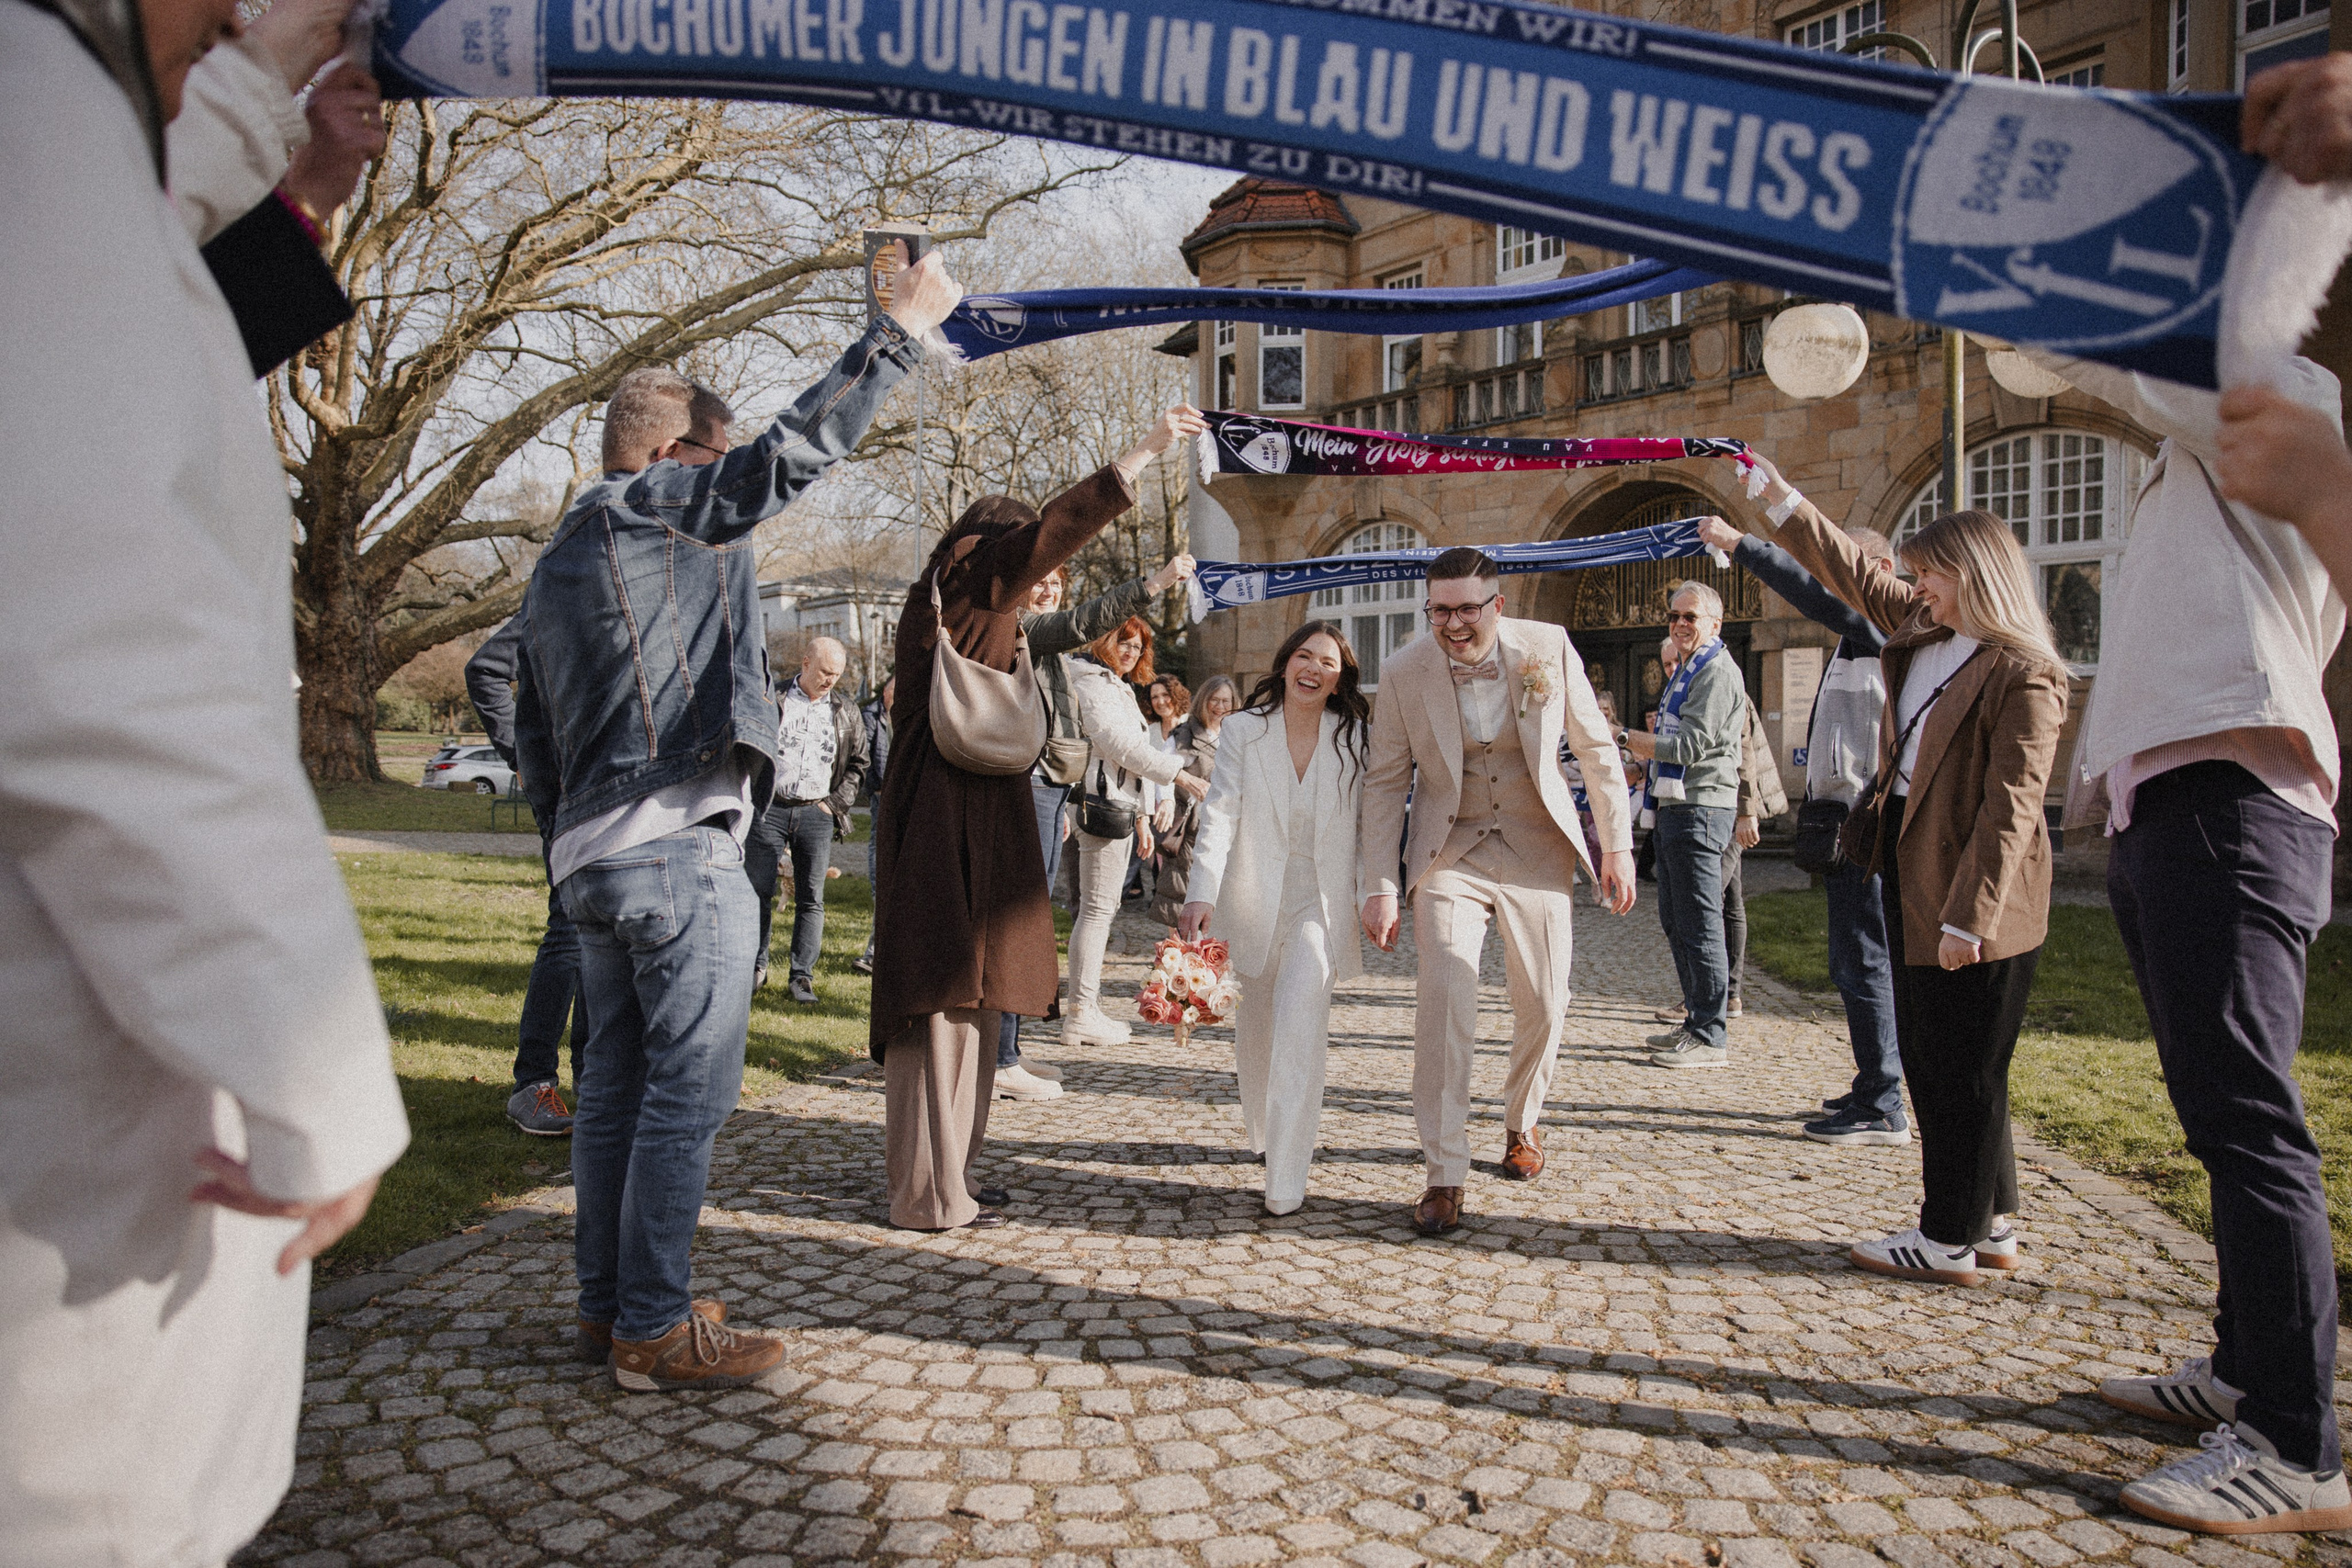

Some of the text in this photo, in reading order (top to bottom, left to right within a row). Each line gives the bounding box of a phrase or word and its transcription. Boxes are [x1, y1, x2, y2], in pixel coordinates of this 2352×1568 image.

[1515, 11, 1638, 56] WIR!
[572, 0, 1872, 231] BOCHUMER JUNGEN IN BLAU UND WEISS
[1063, 114, 1232, 162] STEHEN
[1247, 141, 1311, 173] ZU
[1326, 153, 1424, 196] DIR!
[1267, 436, 1277, 469] Bochum
[1294, 427, 1359, 460] Mein
[1234, 580, 1246, 598] 1848
[1244, 575, 1254, 601] Bochum
[1372, 570, 1397, 580] DES
